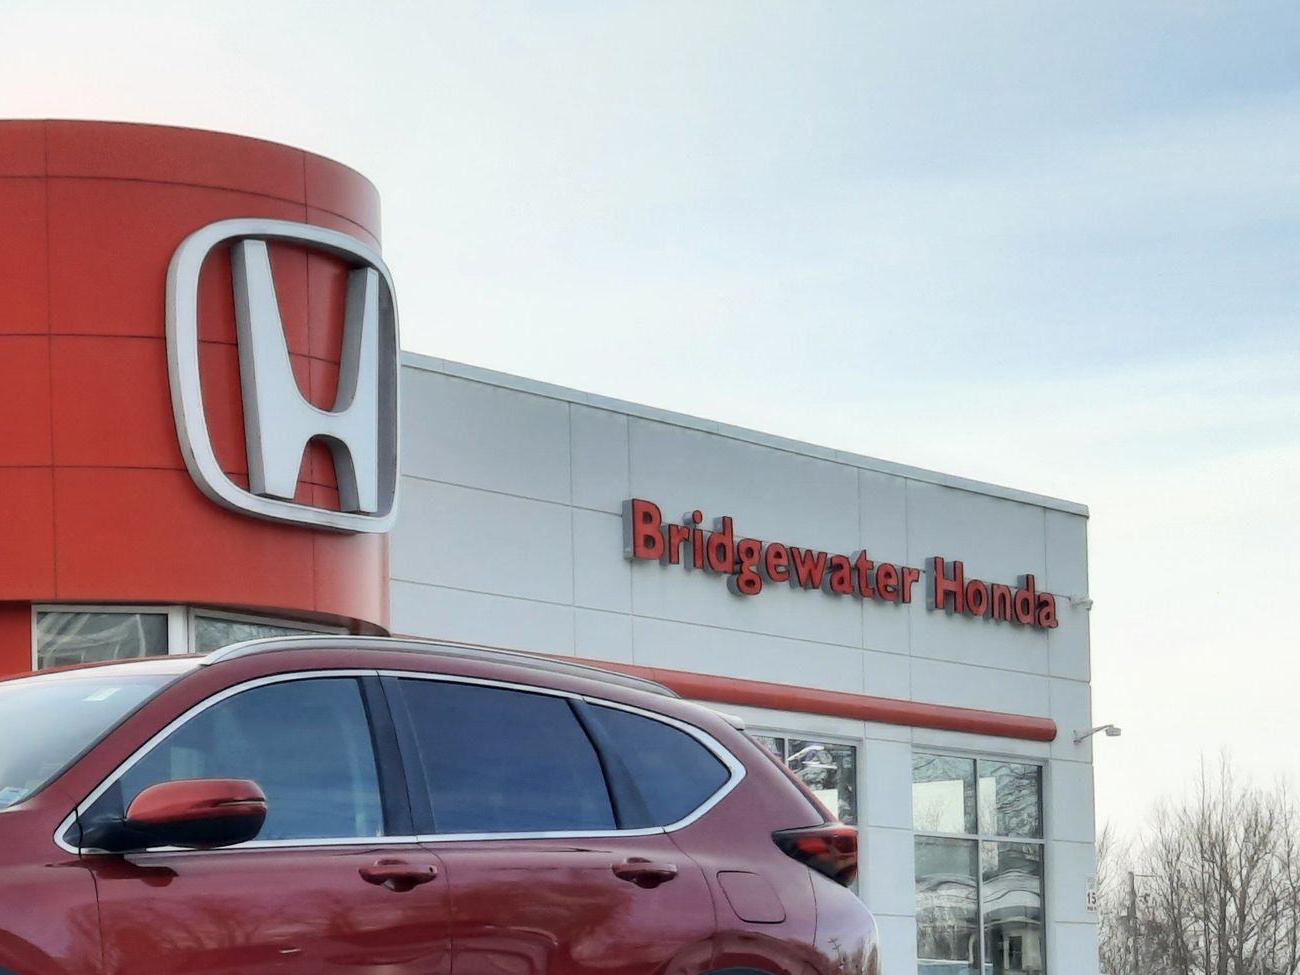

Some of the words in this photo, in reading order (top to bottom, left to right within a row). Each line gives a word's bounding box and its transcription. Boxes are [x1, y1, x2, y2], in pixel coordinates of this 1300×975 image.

[626, 498, 921, 604] Bridgewater
[928, 555, 1059, 629] Honda
[1087, 892, 1097, 905] 15
